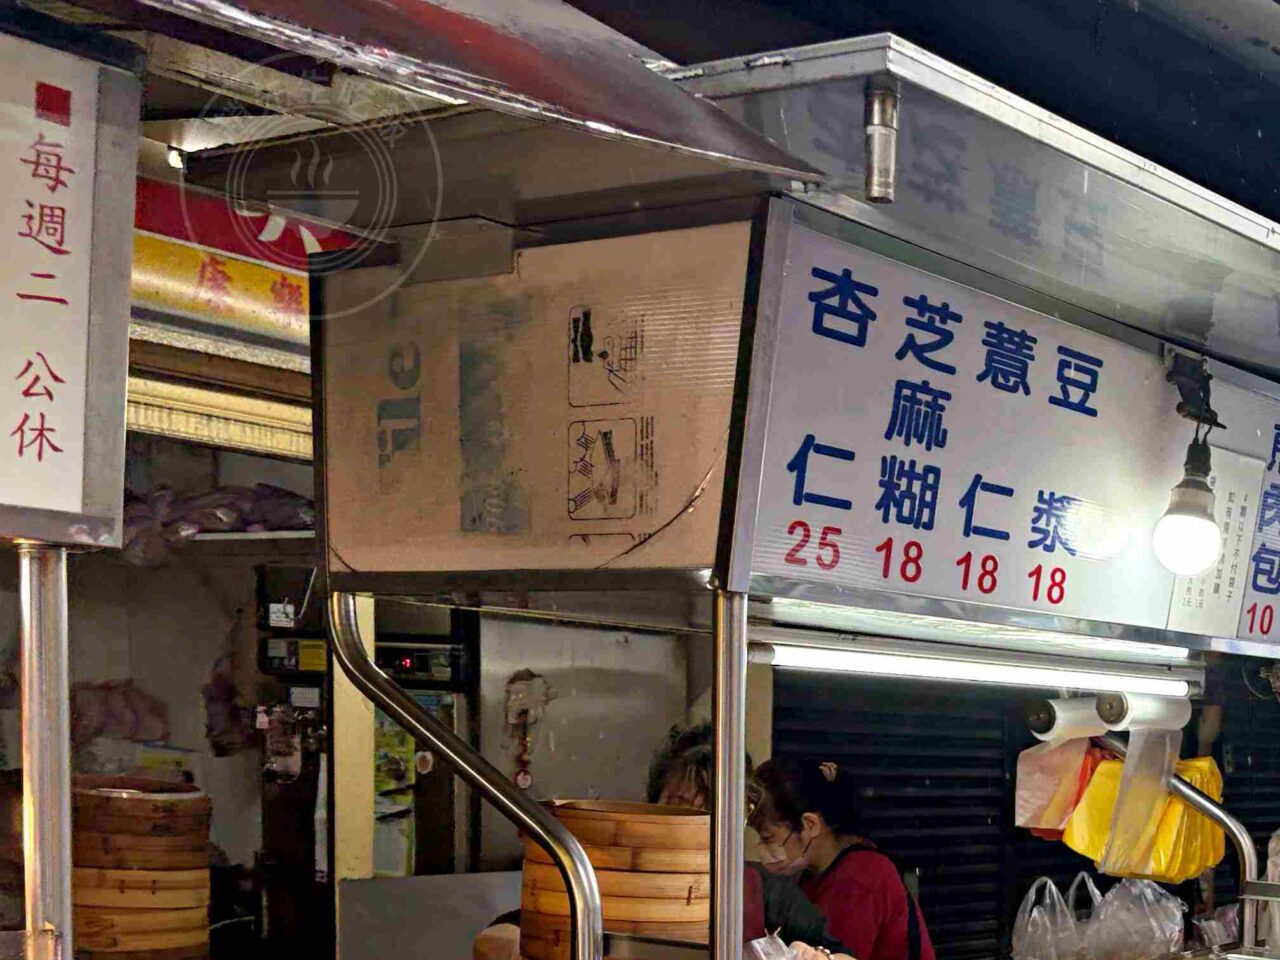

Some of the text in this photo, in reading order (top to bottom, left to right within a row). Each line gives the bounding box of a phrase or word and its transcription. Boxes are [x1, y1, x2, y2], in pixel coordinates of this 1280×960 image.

[9, 133, 75, 463] 每週二 公休
[787, 268, 879, 509] 杏仁
[876, 294, 962, 531] 芝麻糊
[959, 321, 1039, 541] 薏仁
[1028, 347, 1103, 555] 豆漿
[784, 520, 842, 569] 25
[875, 537, 923, 583] 18
[955, 552, 999, 594] 18
[1027, 564, 1066, 605] 18
[1247, 604, 1273, 634] 10
